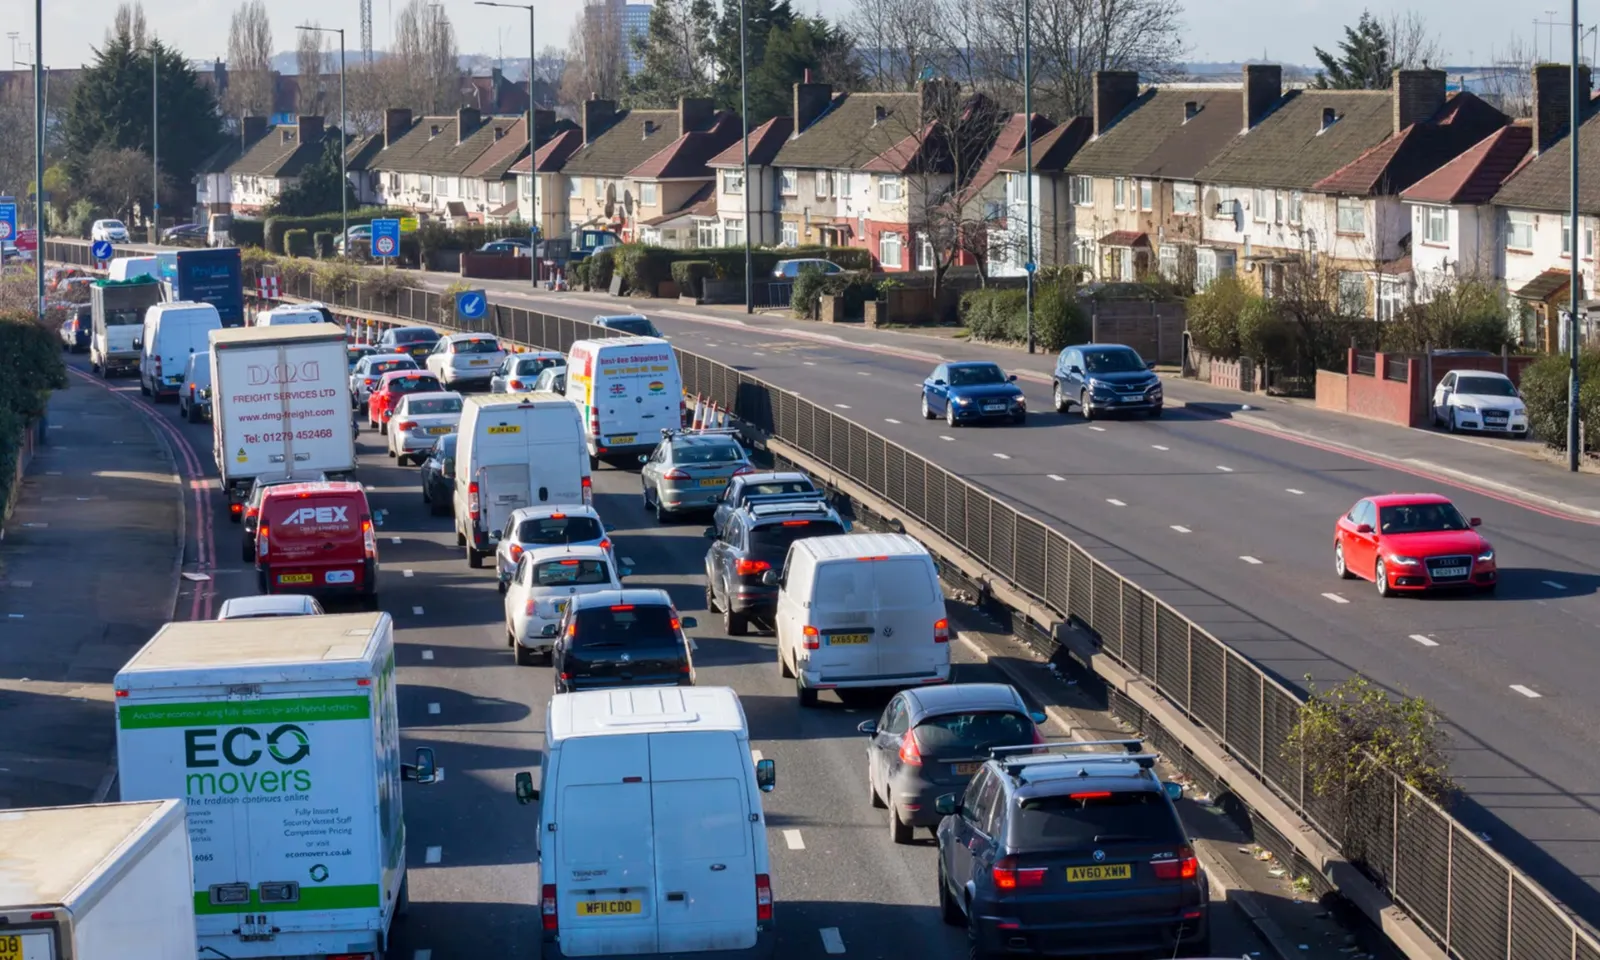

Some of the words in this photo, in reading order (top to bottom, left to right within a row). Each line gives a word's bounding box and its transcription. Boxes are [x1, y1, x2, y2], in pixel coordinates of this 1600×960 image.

[630, 355, 658, 363] Shipping
[232, 393, 272, 404] FREIGHT
[274, 390, 318, 401] SERVICES
[320, 388, 336, 398] LTD
[238, 408, 334, 422] www.dmg-freight.com
[244, 434, 261, 444] Tel:
[263, 432, 293, 442] 01279
[296, 428, 332, 440] 452468
[281, 506, 348, 525] APEX
[286, 704, 299, 713] and
[302, 703, 326, 713] hybrid
[184, 724, 310, 768] ECO
[186, 769, 312, 796] movers
[186, 796, 201, 806] The
[204, 796, 240, 805] tradition
[242, 794, 281, 804] continues
[284, 793, 309, 802] online
[295, 808, 312, 816] Fully
[312, 807, 339, 815] Insured
[283, 819, 311, 827] Security
[336, 816, 352, 824] Staff
[284, 829, 326, 837] Competitive
[194, 854, 214, 862] 6065
[285, 848, 352, 858] ecomovers.co.uk
[1072, 868, 1101, 880] AV60
[586, 902, 607, 914] WF11
